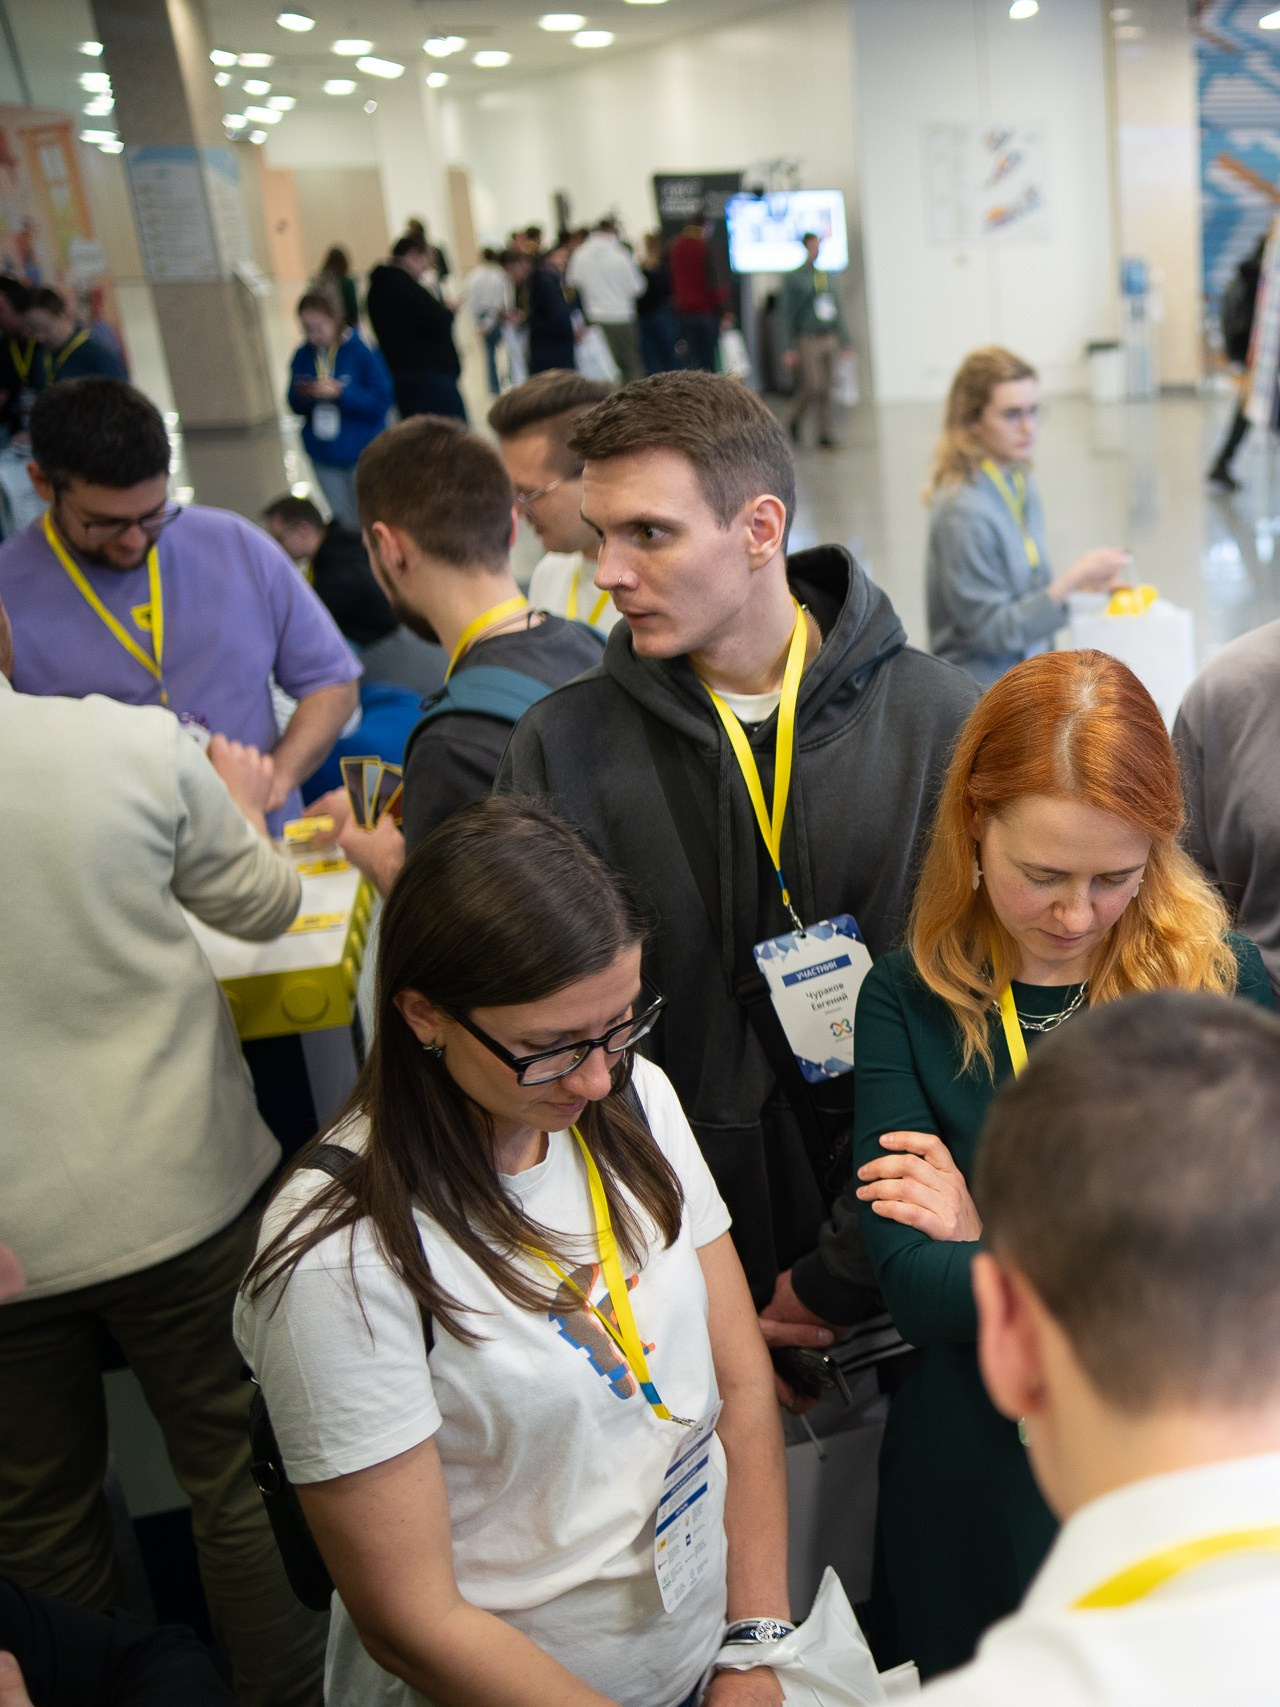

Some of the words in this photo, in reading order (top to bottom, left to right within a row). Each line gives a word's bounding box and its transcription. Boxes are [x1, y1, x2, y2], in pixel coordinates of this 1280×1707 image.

[796, 961, 838, 980] УЧАСТНИК
[805, 983, 845, 1000] Чураков
[811, 993, 849, 1011] Евгений
